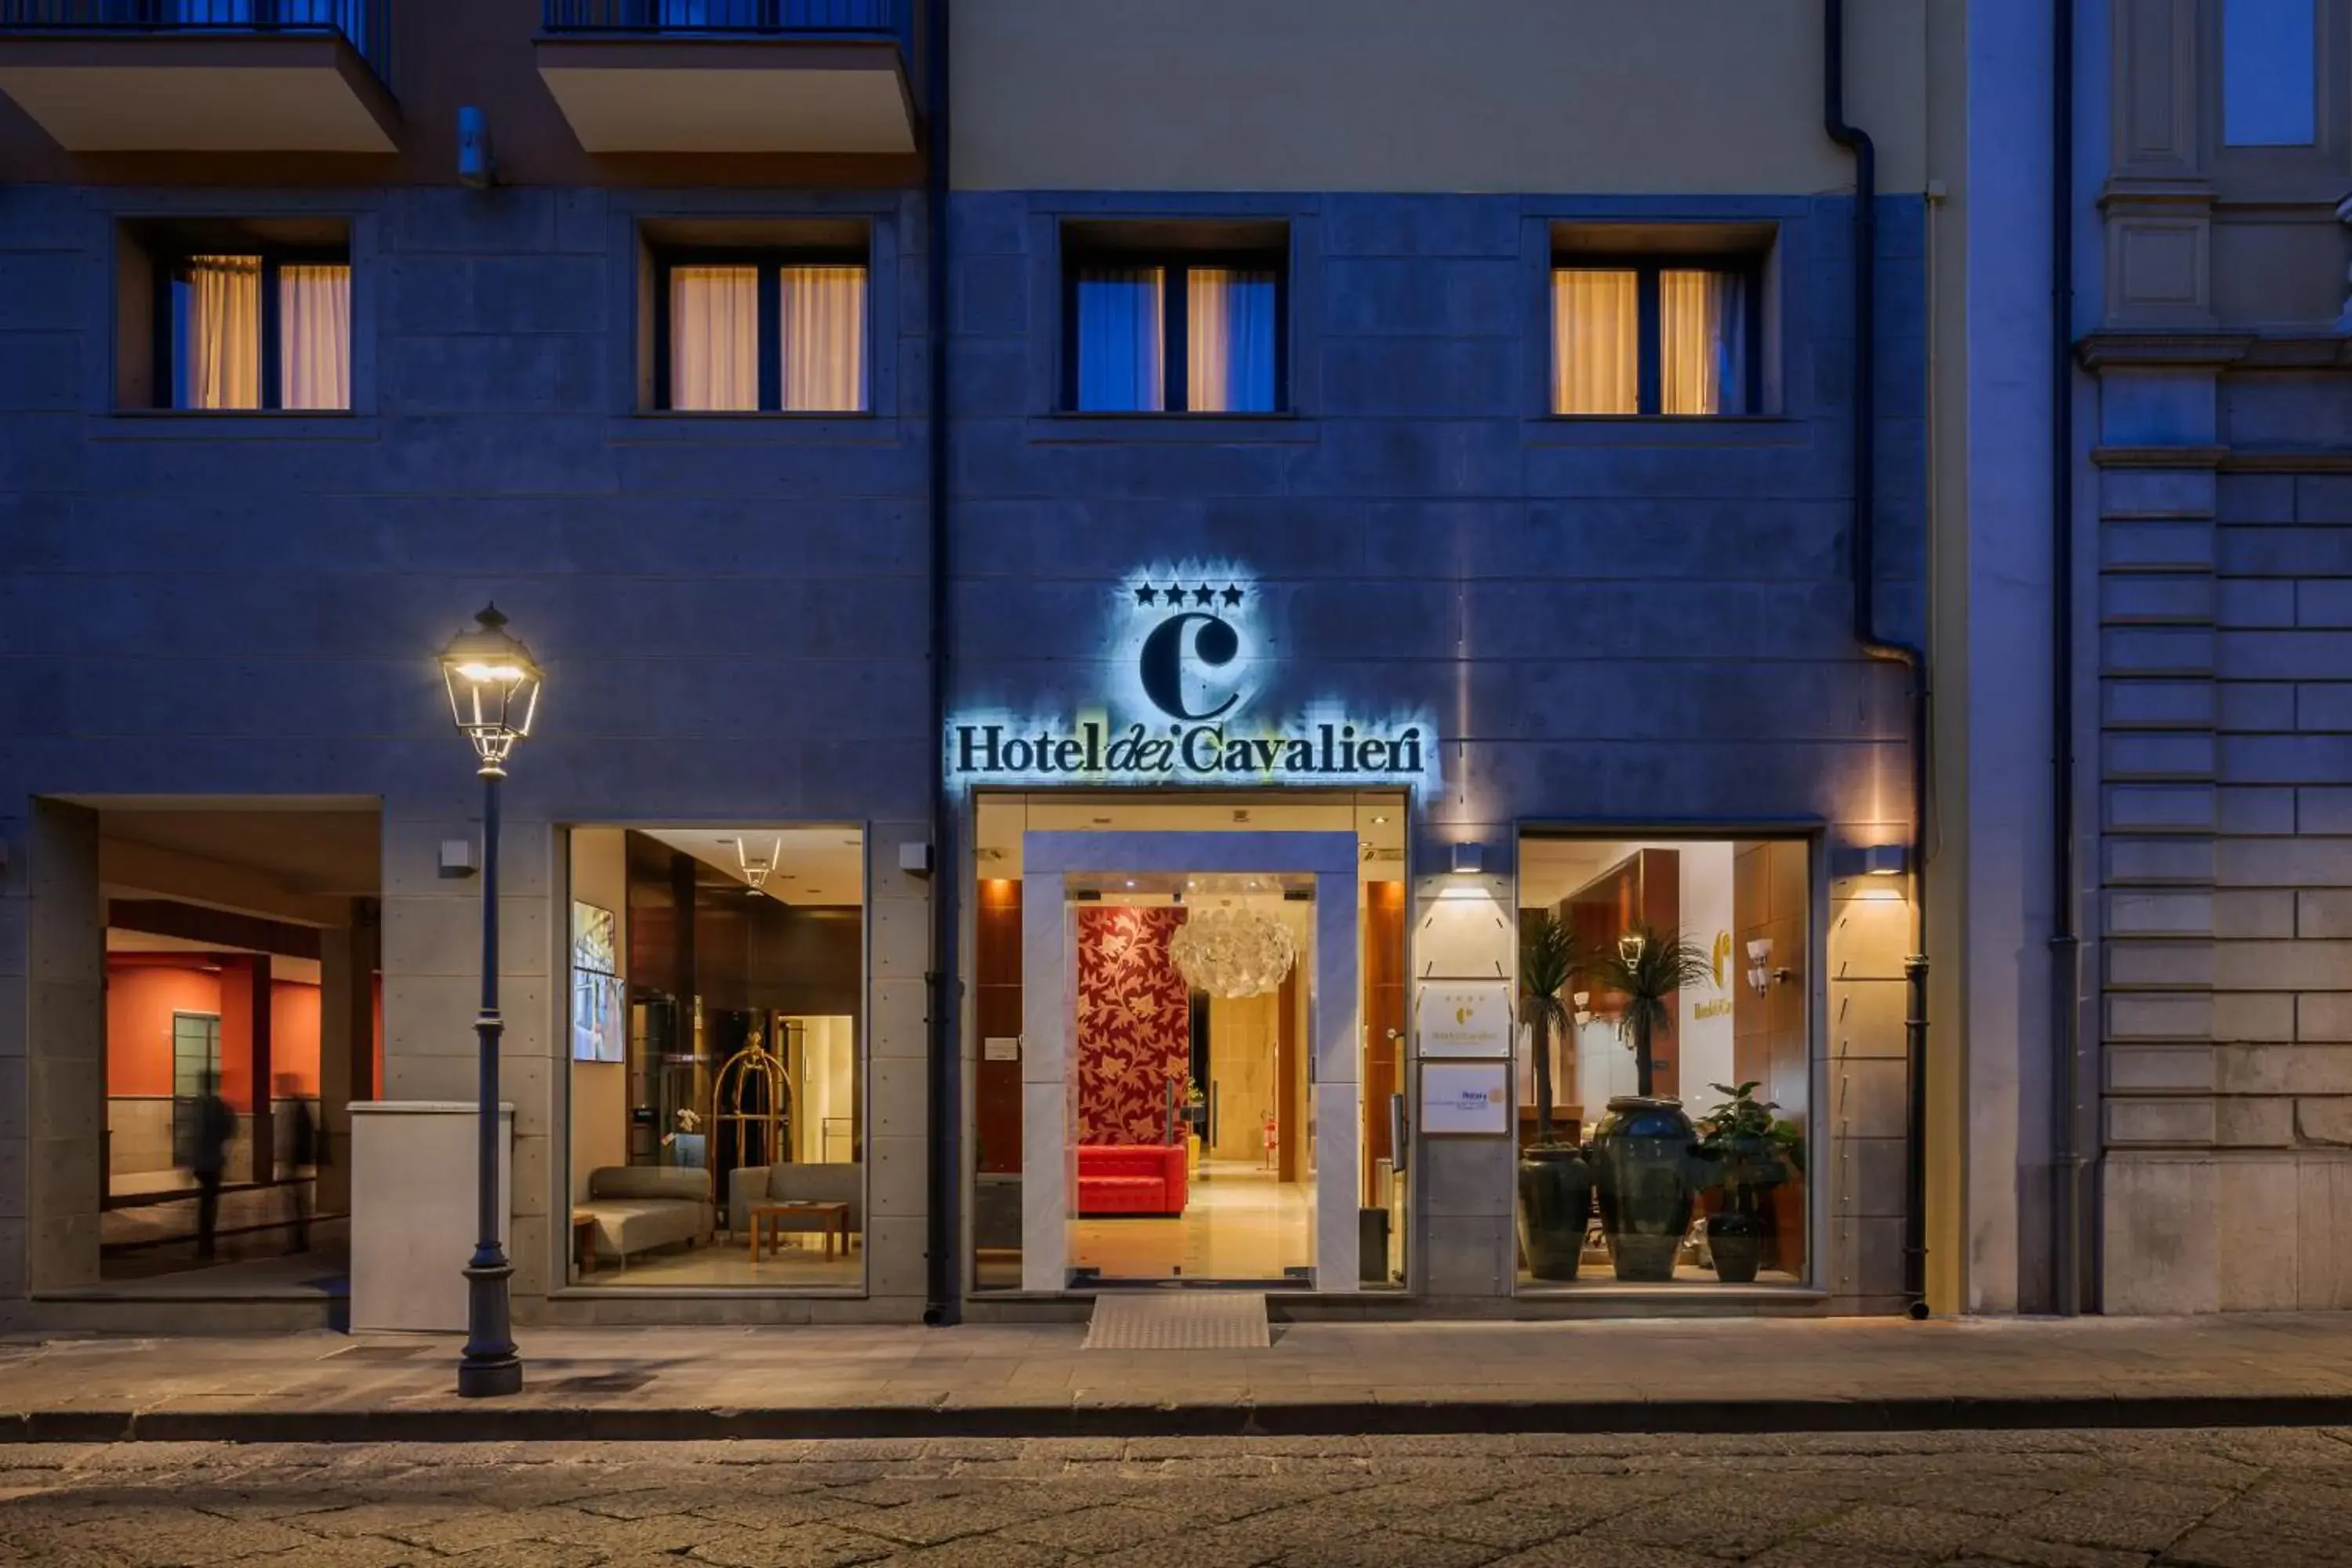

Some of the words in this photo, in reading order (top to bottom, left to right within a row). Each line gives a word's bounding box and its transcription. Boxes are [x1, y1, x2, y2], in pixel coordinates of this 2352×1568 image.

[956, 722, 1103, 772] Hotel
[1105, 723, 1182, 772] dei
[1181, 724, 1425, 773] Cavalieri
